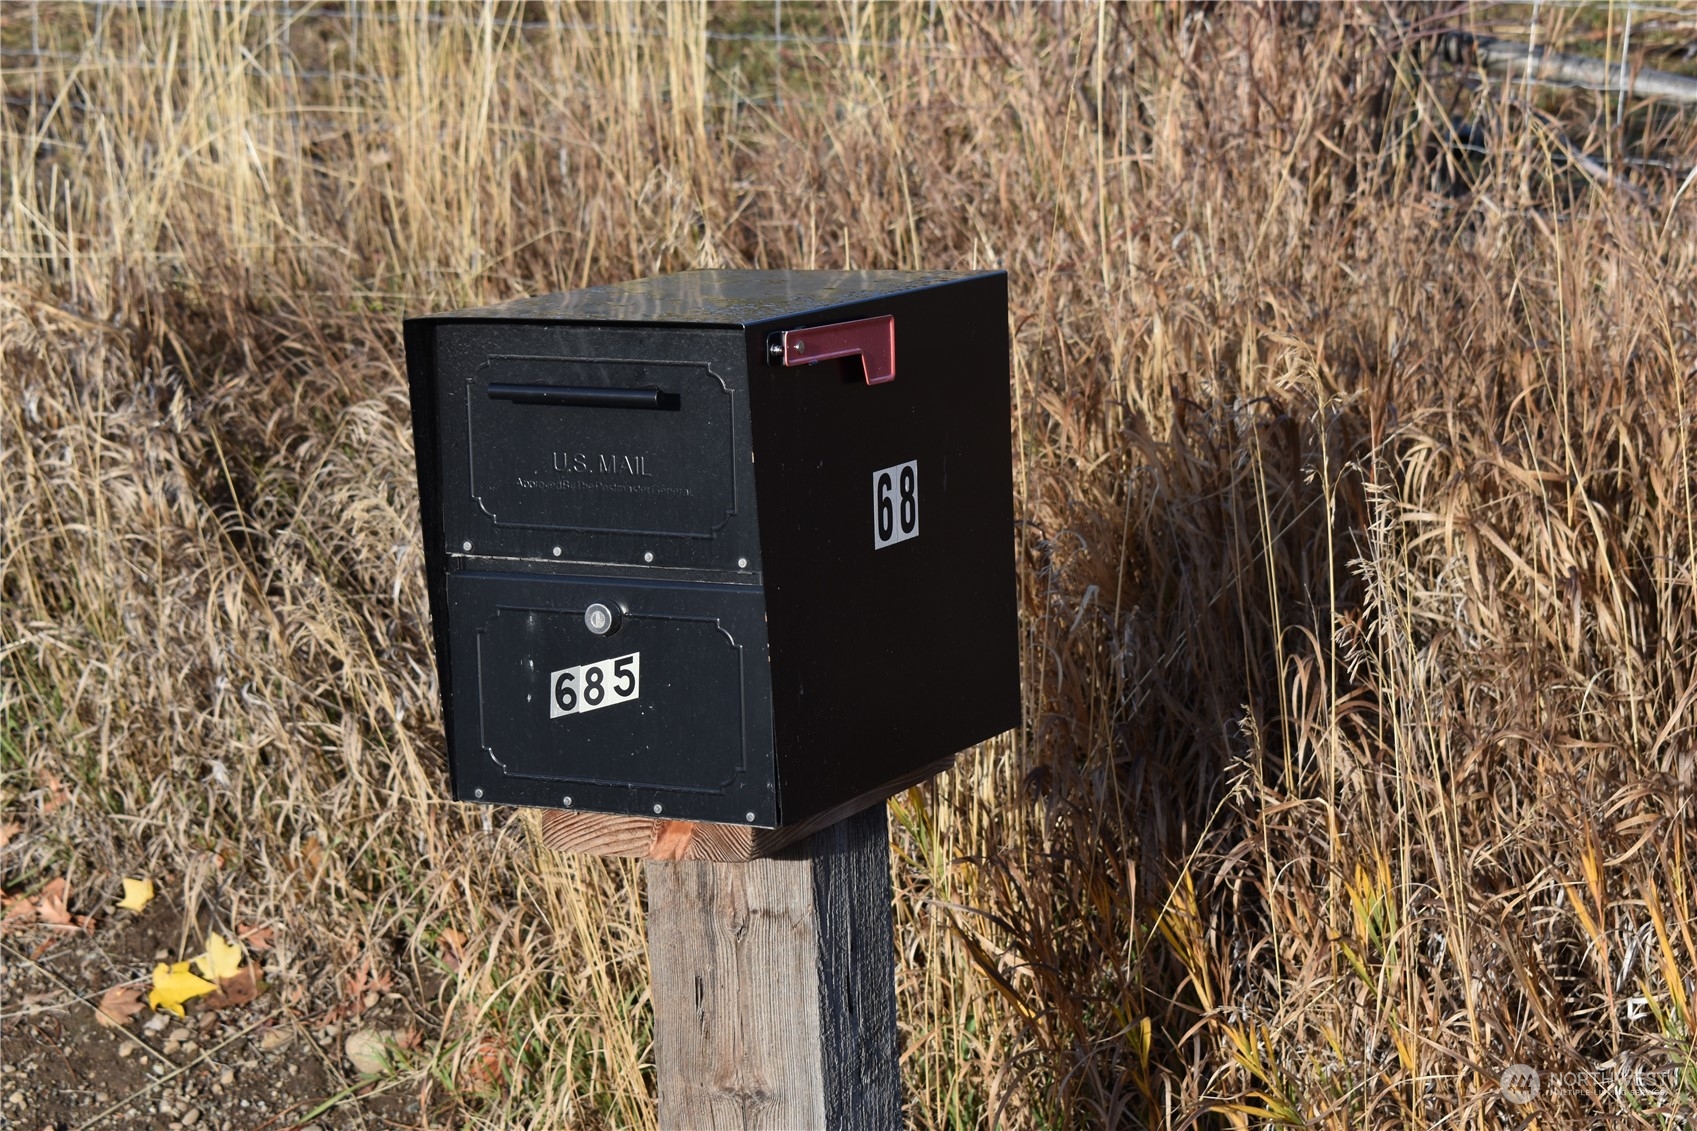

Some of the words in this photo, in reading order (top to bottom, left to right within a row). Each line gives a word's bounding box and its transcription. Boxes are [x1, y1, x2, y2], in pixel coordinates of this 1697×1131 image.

[552, 452, 593, 473] U.S.
[599, 454, 653, 477] MAIL
[878, 466, 915, 541] 68
[555, 656, 635, 711] 685
